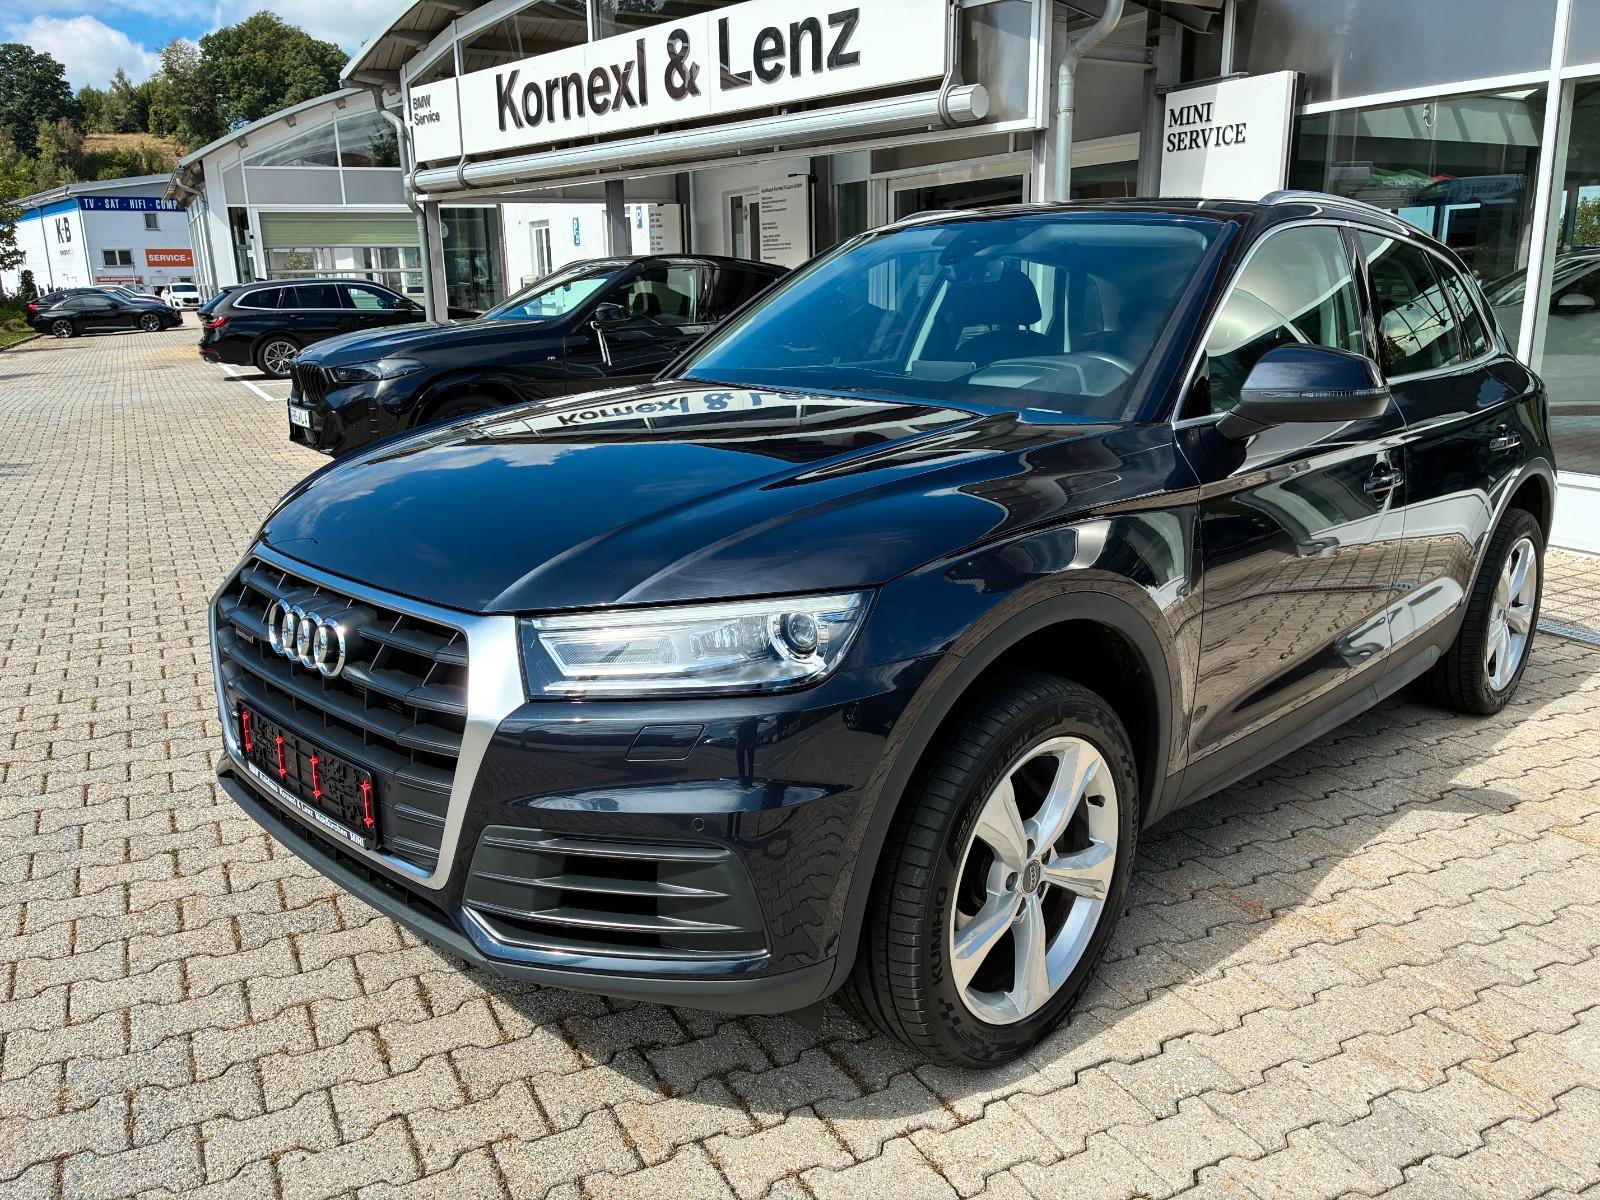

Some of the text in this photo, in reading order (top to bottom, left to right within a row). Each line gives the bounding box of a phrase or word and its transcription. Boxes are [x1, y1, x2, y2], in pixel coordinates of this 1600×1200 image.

[495, 7, 862, 133] Kornexl & Lenz
[412, 94, 431, 110] BMW
[414, 110, 441, 126] Service
[1168, 101, 1213, 128] MINI
[1166, 122, 1247, 153] SERVICE
[83, 198, 95, 209] TV
[104, 198, 119, 209] SAT
[129, 199, 147, 209] HIFI
[148, 254, 187, 262] SERVICE
[930, 886, 949, 986] KUMHO
